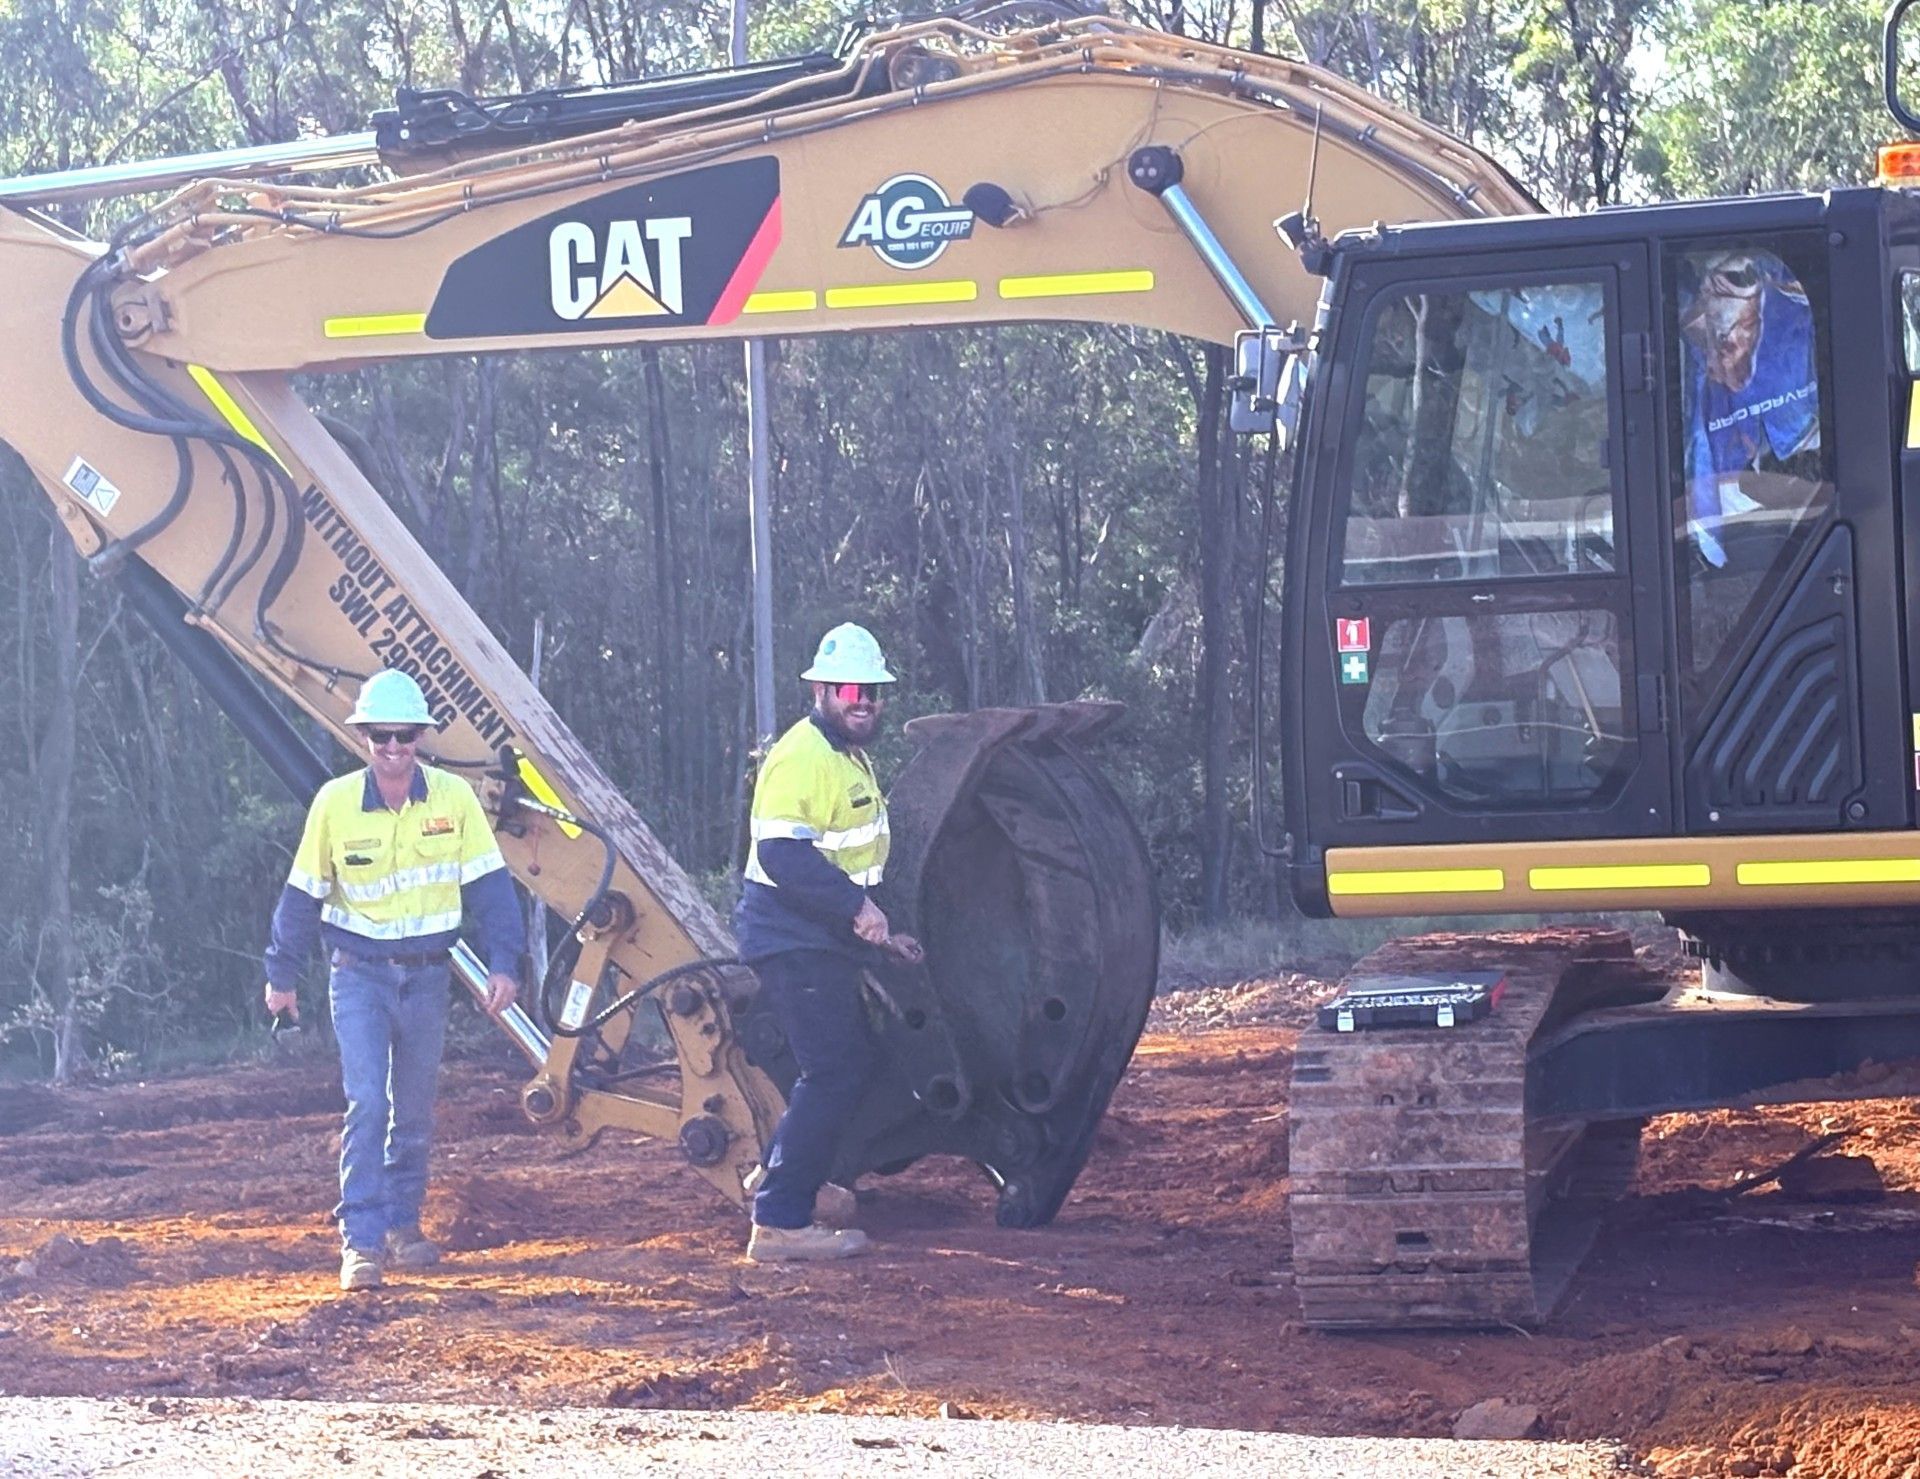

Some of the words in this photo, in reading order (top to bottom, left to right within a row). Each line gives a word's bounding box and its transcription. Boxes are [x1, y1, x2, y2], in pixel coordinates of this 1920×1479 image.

[846, 197, 972, 242] AG
[921, 220, 971, 237] EQUIP
[549, 217, 692, 321] CAT
[300, 484, 395, 602] WITHOUT
[382, 594, 516, 750] ATTACHMENT
[328, 574, 381, 638] SWL
